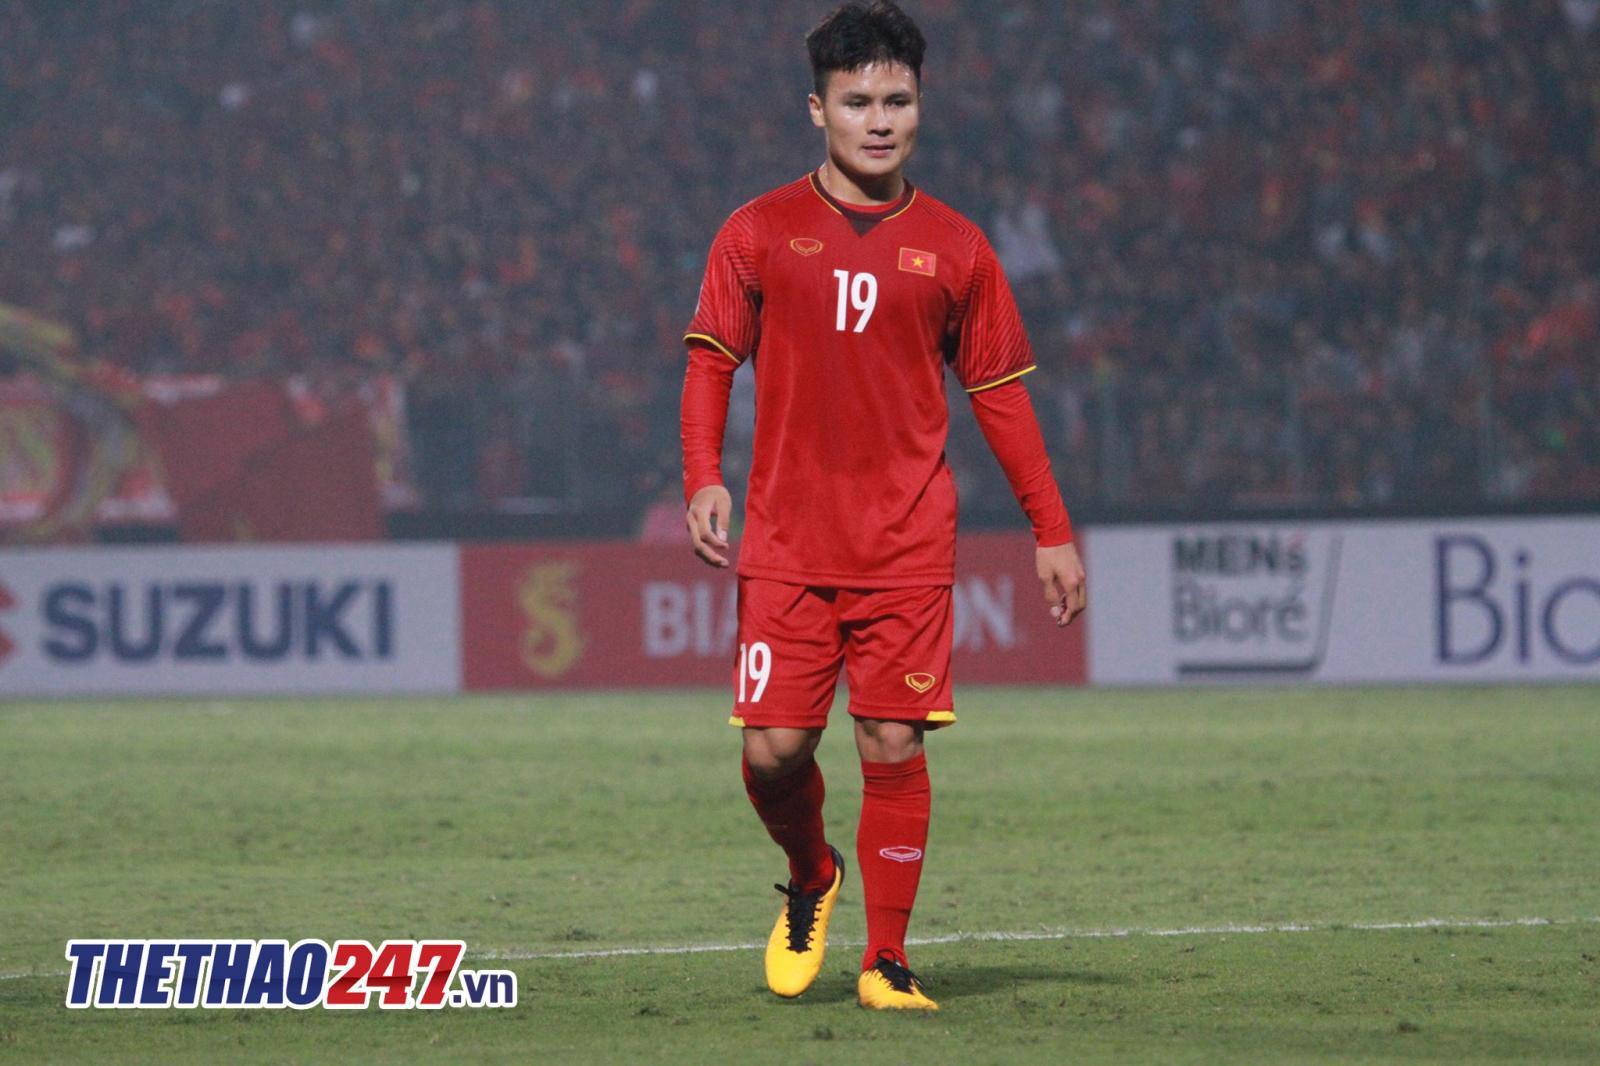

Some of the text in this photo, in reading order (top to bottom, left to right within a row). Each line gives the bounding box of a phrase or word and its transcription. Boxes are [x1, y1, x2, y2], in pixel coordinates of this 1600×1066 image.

[833, 268, 878, 333] 19
[42, 580, 395, 664] SUZUKI
[738, 641, 772, 703] 19
